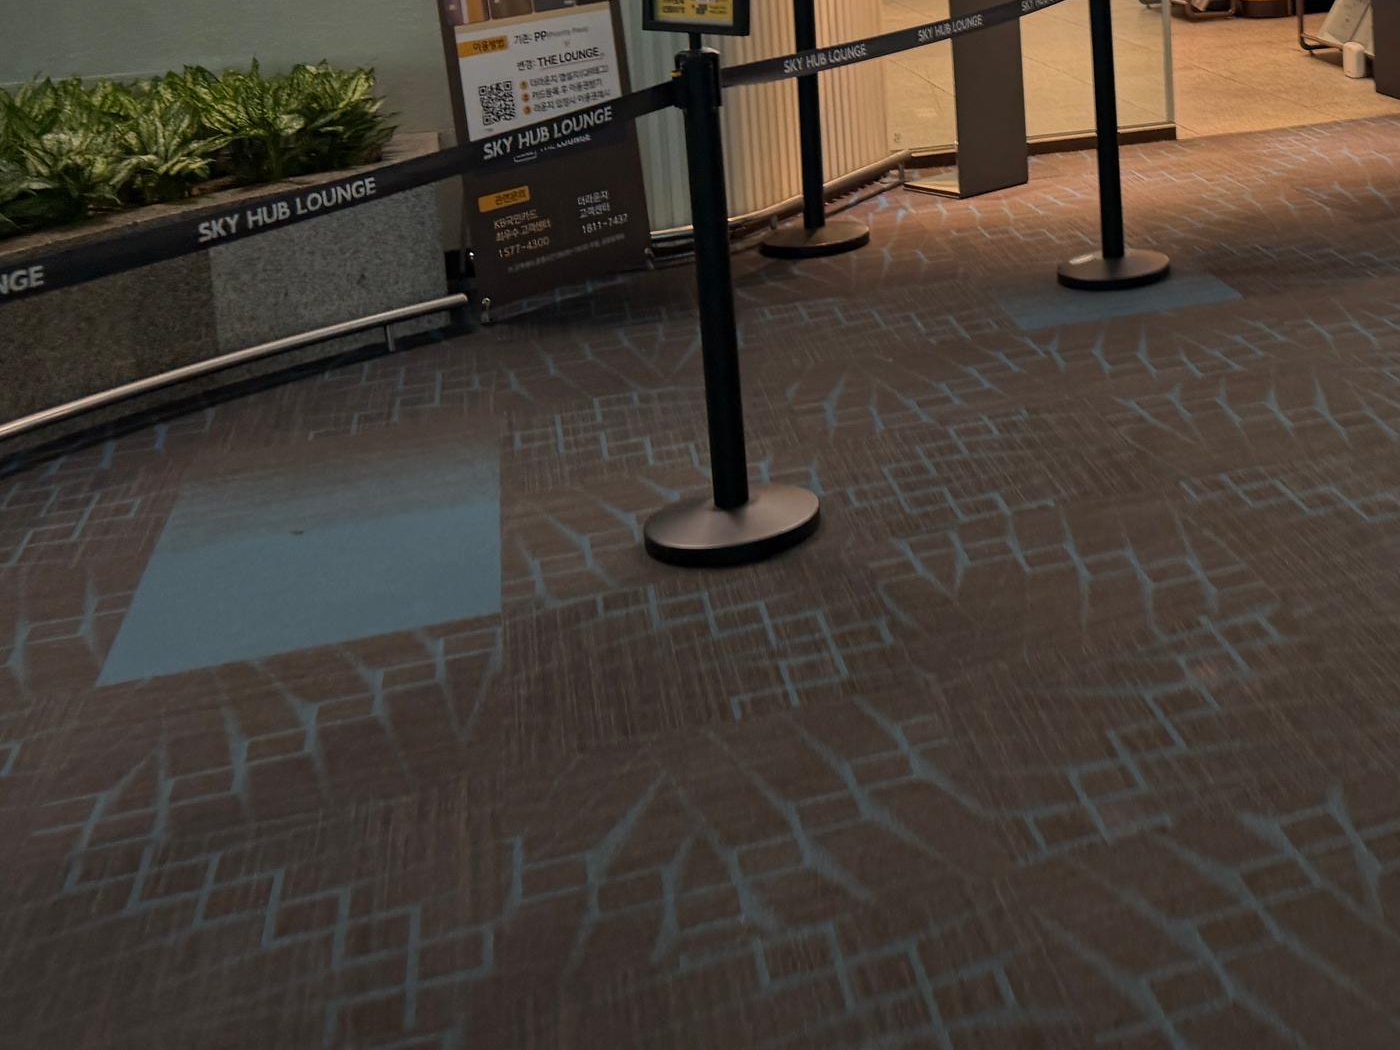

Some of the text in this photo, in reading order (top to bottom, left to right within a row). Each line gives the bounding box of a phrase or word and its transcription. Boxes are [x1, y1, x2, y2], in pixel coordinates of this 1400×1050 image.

[1021, 0, 1035, 12] SKY
[917, 13, 984, 42] SKY HUB LOUNGE
[537, 53, 559, 68] THE
[559, 47, 600, 63] LOUNGE
[783, 43, 868, 74] SKY HUB LOUNGE
[483, 133, 513, 161] SKY
[518, 127, 550, 150] HUB
[553, 105, 613, 137] LOUNGE
[198, 177, 377, 243] SKY HUB LOUNGE
